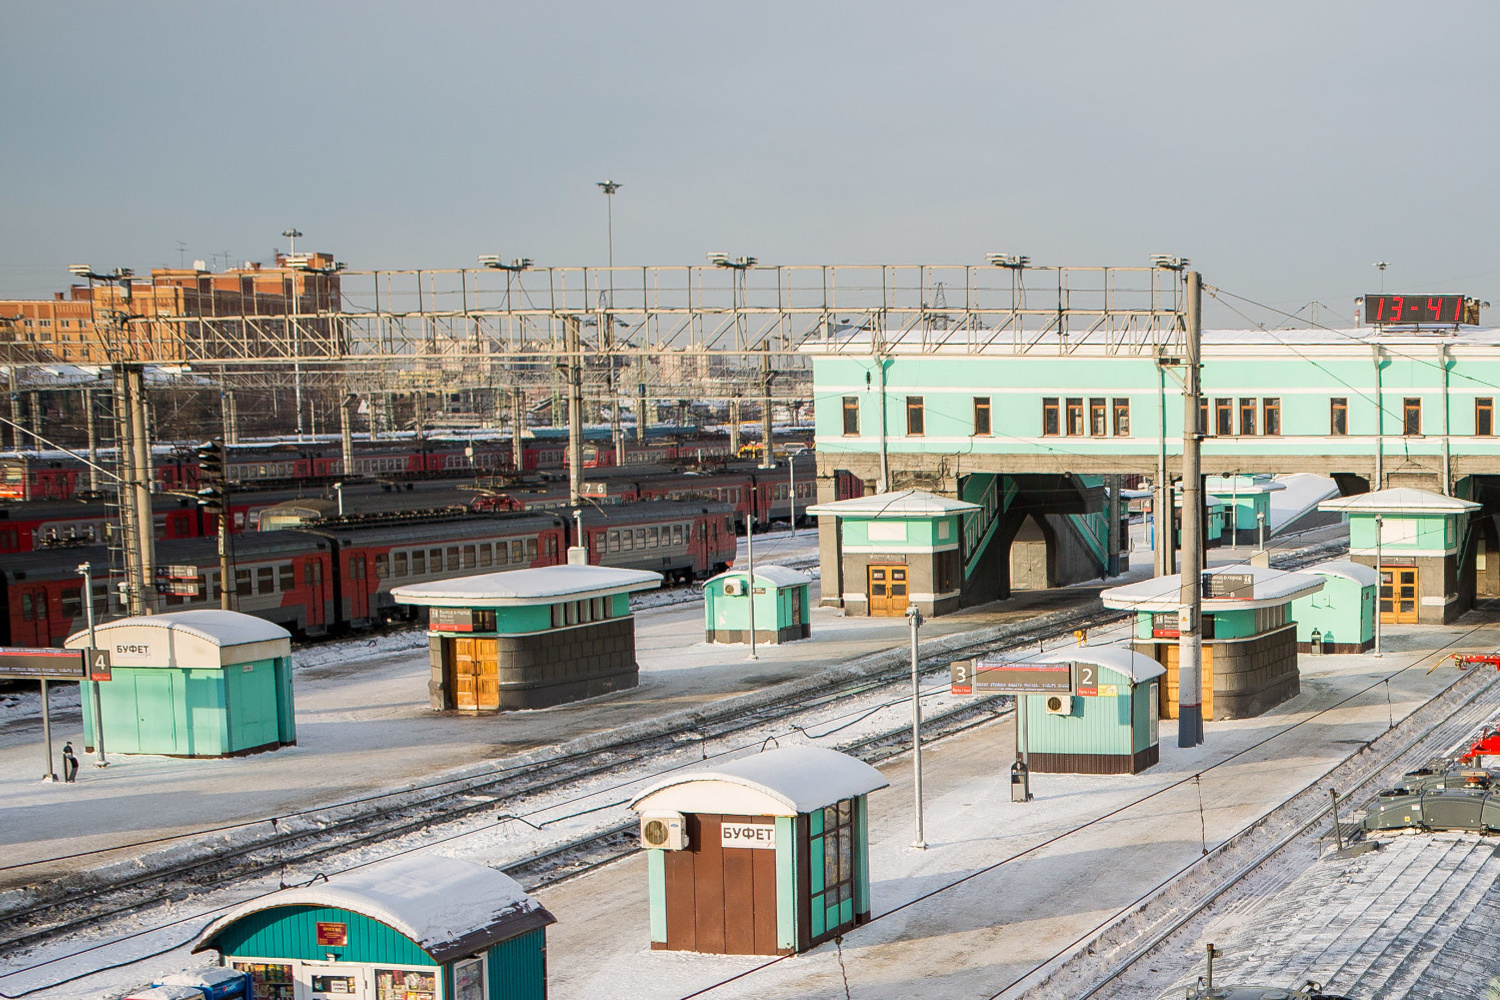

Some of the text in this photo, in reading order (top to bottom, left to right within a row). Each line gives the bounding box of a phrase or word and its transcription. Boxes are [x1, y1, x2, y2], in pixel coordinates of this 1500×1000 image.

[1376, 296, 1462, 322] 13-41
[585, 484, 604, 493] 7 6
[116, 644, 149, 655] БУФЕТ
[94, 654, 106, 670] 4
[956, 666, 967, 684] 3
[1082, 668, 1093, 685] 2
[723, 827, 774, 841] БУФЕТ
